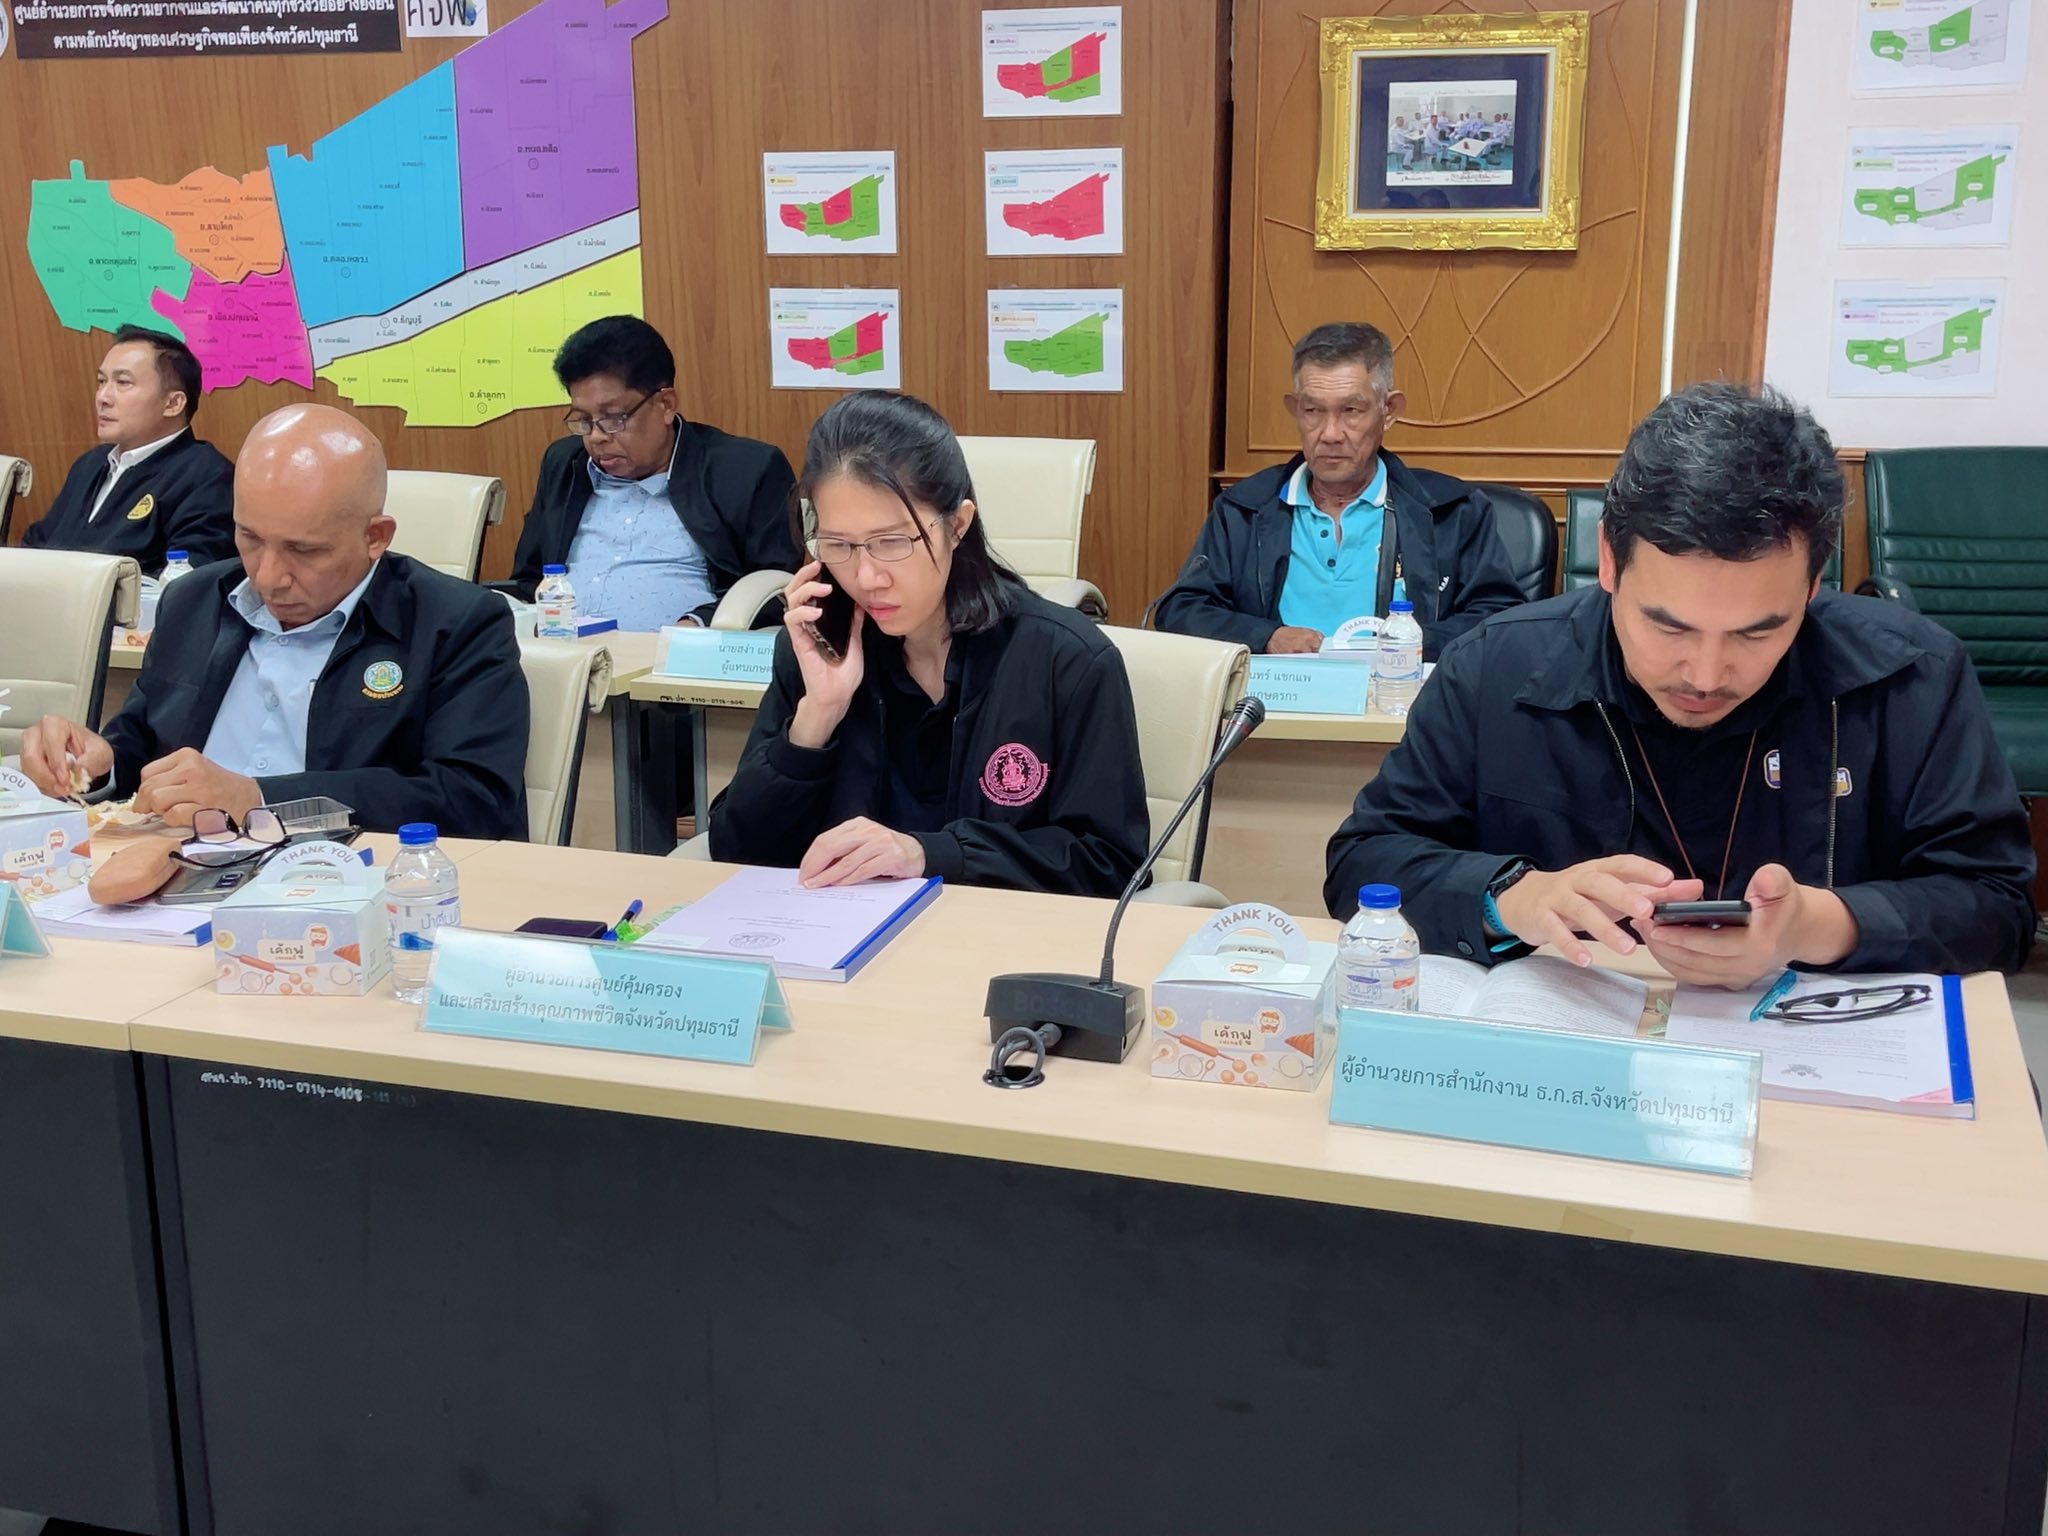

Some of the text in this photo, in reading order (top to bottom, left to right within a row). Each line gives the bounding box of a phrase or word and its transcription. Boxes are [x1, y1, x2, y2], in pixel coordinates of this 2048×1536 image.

[2, 772, 27, 789] YOU
[281, 845, 354, 864] THANK YOU
[1212, 908, 1295, 936] THANK YOU
[504, 961, 684, 1000] ผู้อำนวยการศูนย์คุ้มครอง
[439, 992, 740, 1039] และเสริมสร้างคุณภาพชีวิตจังหวัดปทุมธานี
[1341, 1054, 1735, 1126] ผู้อำนวยการสำนักงาน ธ.ก.ส.จังหวัดปทุมธานี
